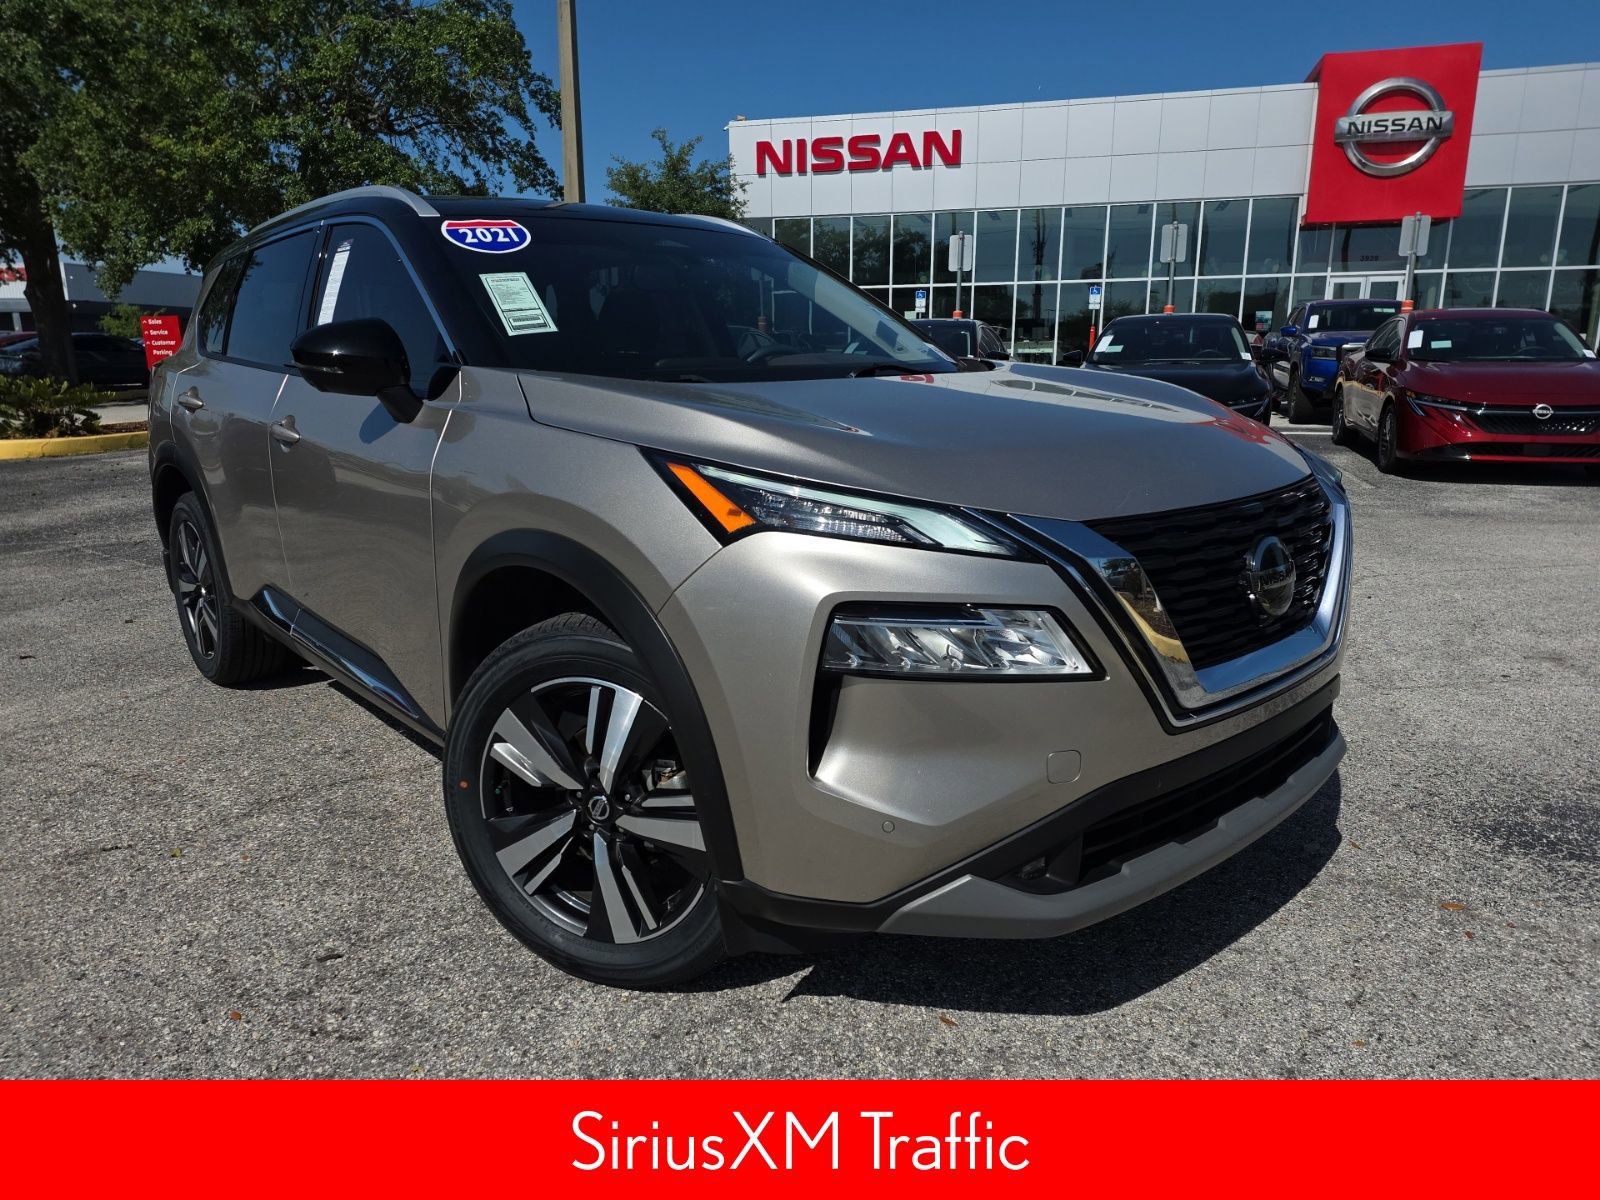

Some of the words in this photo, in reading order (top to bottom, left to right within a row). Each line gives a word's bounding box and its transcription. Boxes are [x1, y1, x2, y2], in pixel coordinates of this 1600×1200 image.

[1347, 116, 1444, 136] NISSAN
[756, 129, 962, 178] NISSAN
[458, 227, 520, 244] 2021
[152, 349, 173, 357] Parking
